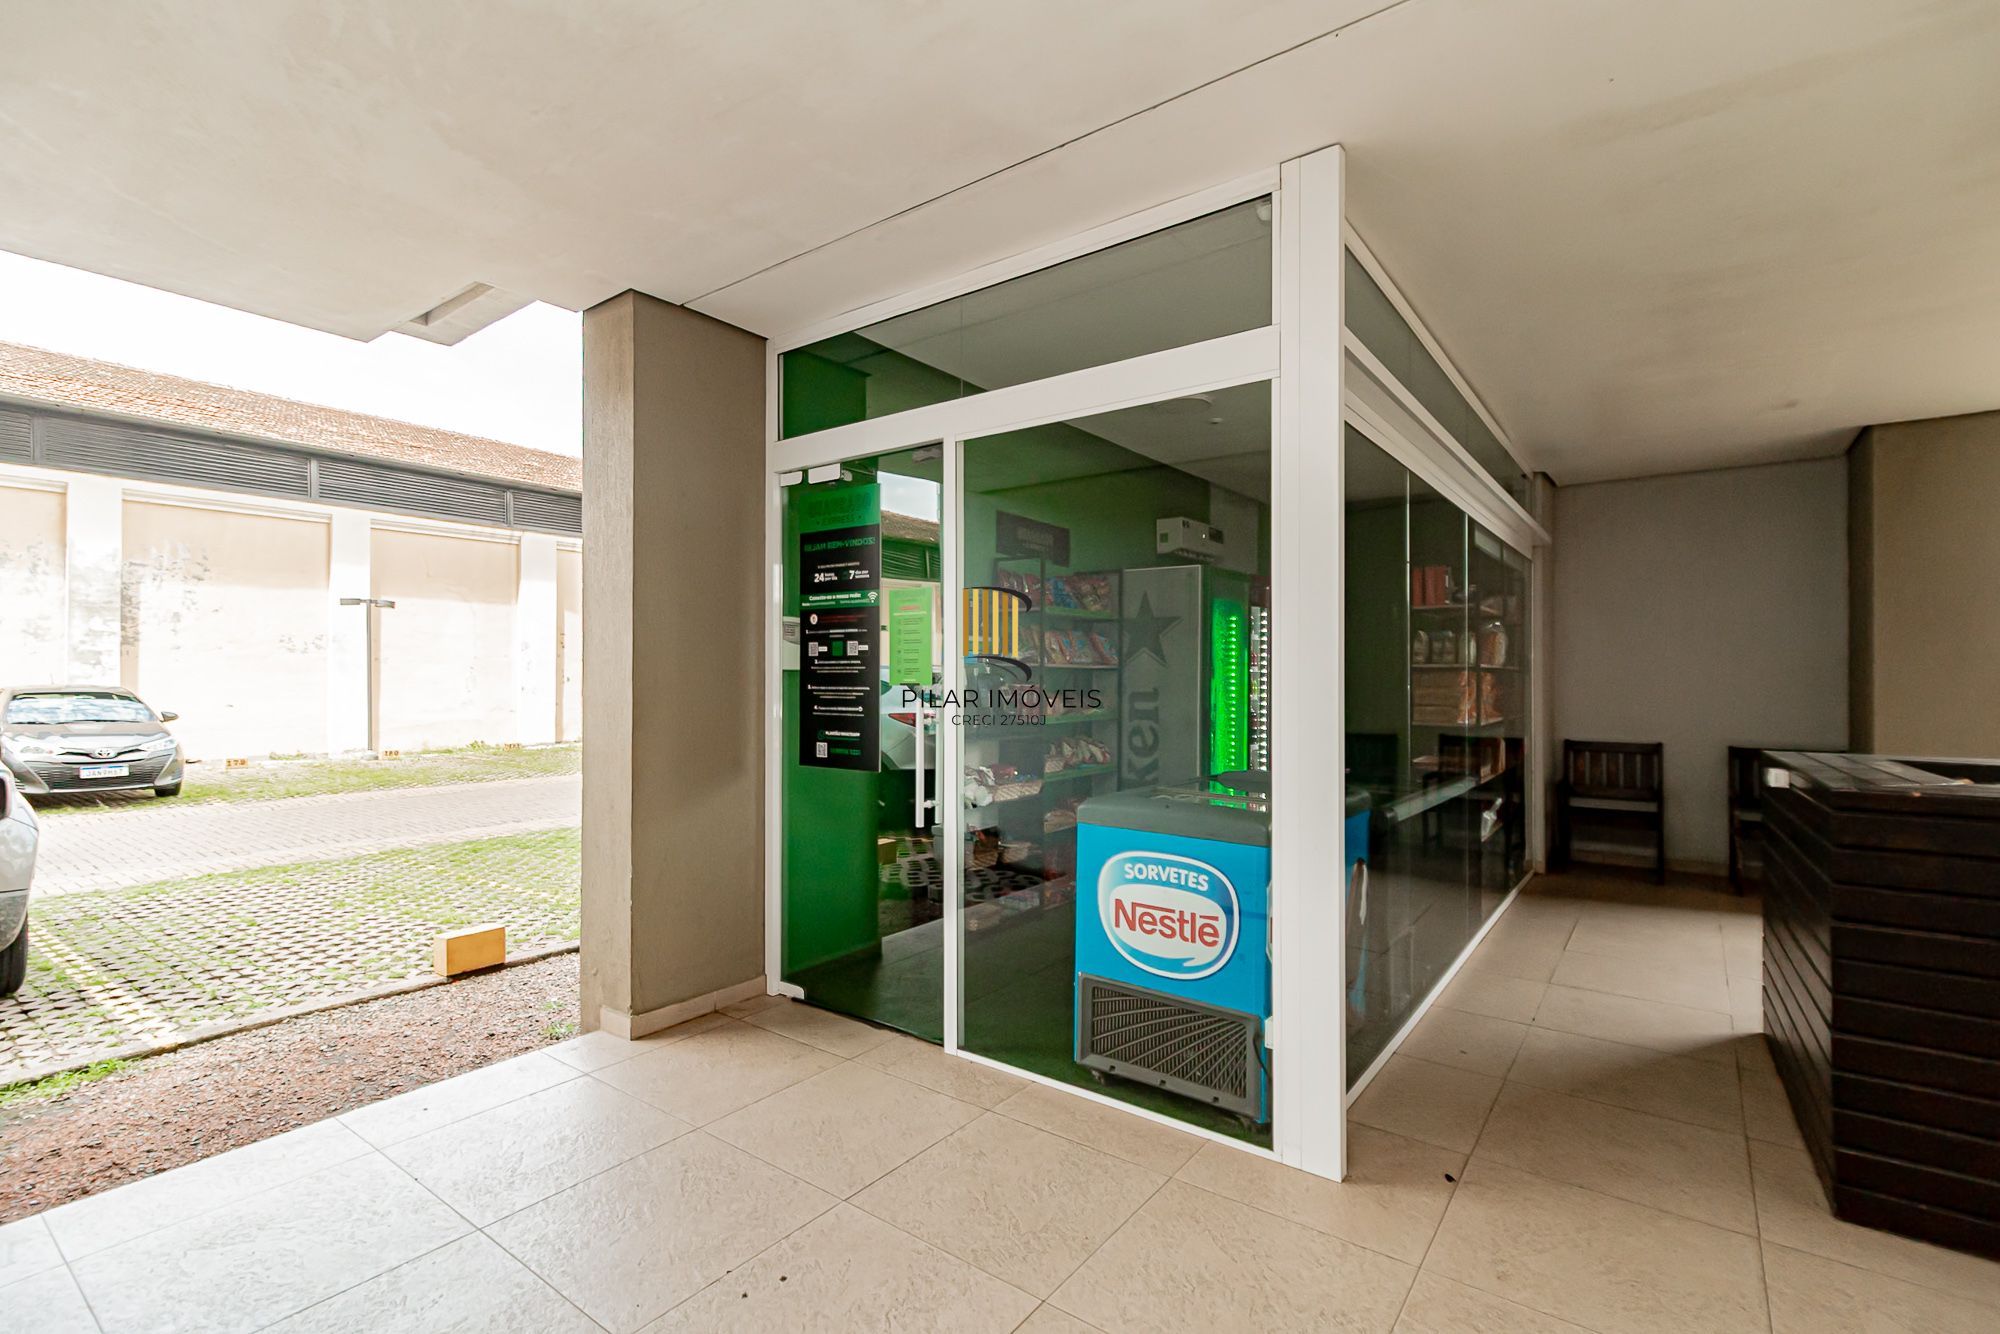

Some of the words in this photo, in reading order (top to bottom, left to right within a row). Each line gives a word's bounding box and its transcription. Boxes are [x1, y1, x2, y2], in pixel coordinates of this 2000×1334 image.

[814, 572, 825, 583] 24
[849, 570, 855, 580] 7
[1123, 863, 1209, 892] SORVETES
